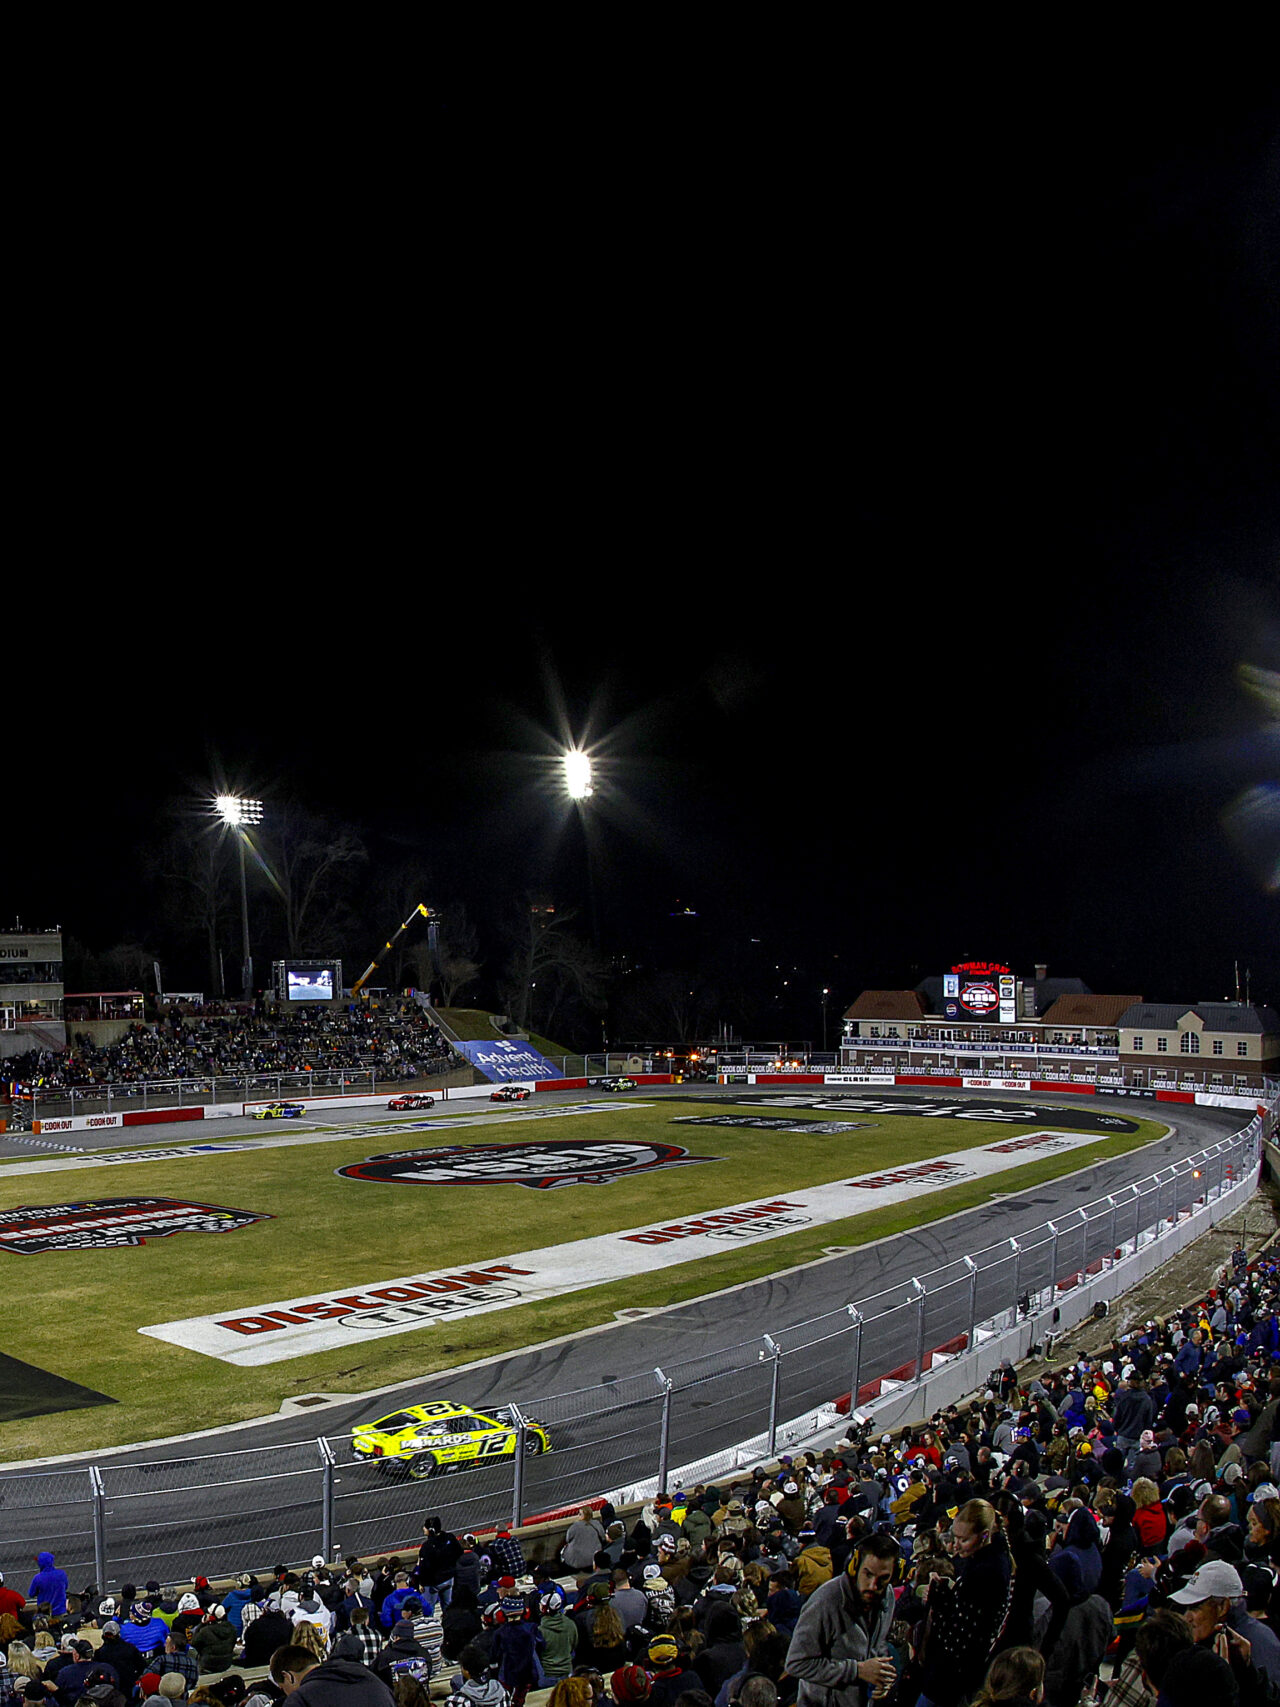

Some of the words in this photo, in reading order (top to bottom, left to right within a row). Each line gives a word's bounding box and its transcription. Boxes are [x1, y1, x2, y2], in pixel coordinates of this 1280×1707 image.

[951, 962, 987, 974] BOWMAN
[988, 963, 1011, 974] GRAY
[475, 1050, 537, 1066] Advent
[493, 1063, 552, 1077] Health
[1208, 1084, 1223, 1093] COOK
[1224, 1085, 1234, 1094] OUT
[1238, 1087, 1253, 1096] COOK
[44, 1121, 61, 1131] COOK
[61, 1120, 73, 1129] OUT
[90, 1117, 106, 1127] COOK
[106, 1116, 118, 1125] OUT
[983, 1135, 1065, 1153] DISCOUNT
[1028, 1139, 1077, 1153] TIRE
[391, 1143, 652, 1181] CLASH
[845, 1161, 965, 1190] DISCOUNT
[913, 1170, 970, 1186] TIRE
[96, 1222, 150, 1236] OUT
[619, 1200, 808, 1245] DISCOUNT
[717, 1215, 802, 1239] TIRE
[215, 1264, 537, 1336] DISCOUNT
[359, 1288, 510, 1323] TIRE
[477, 1435, 507, 1456] 12
